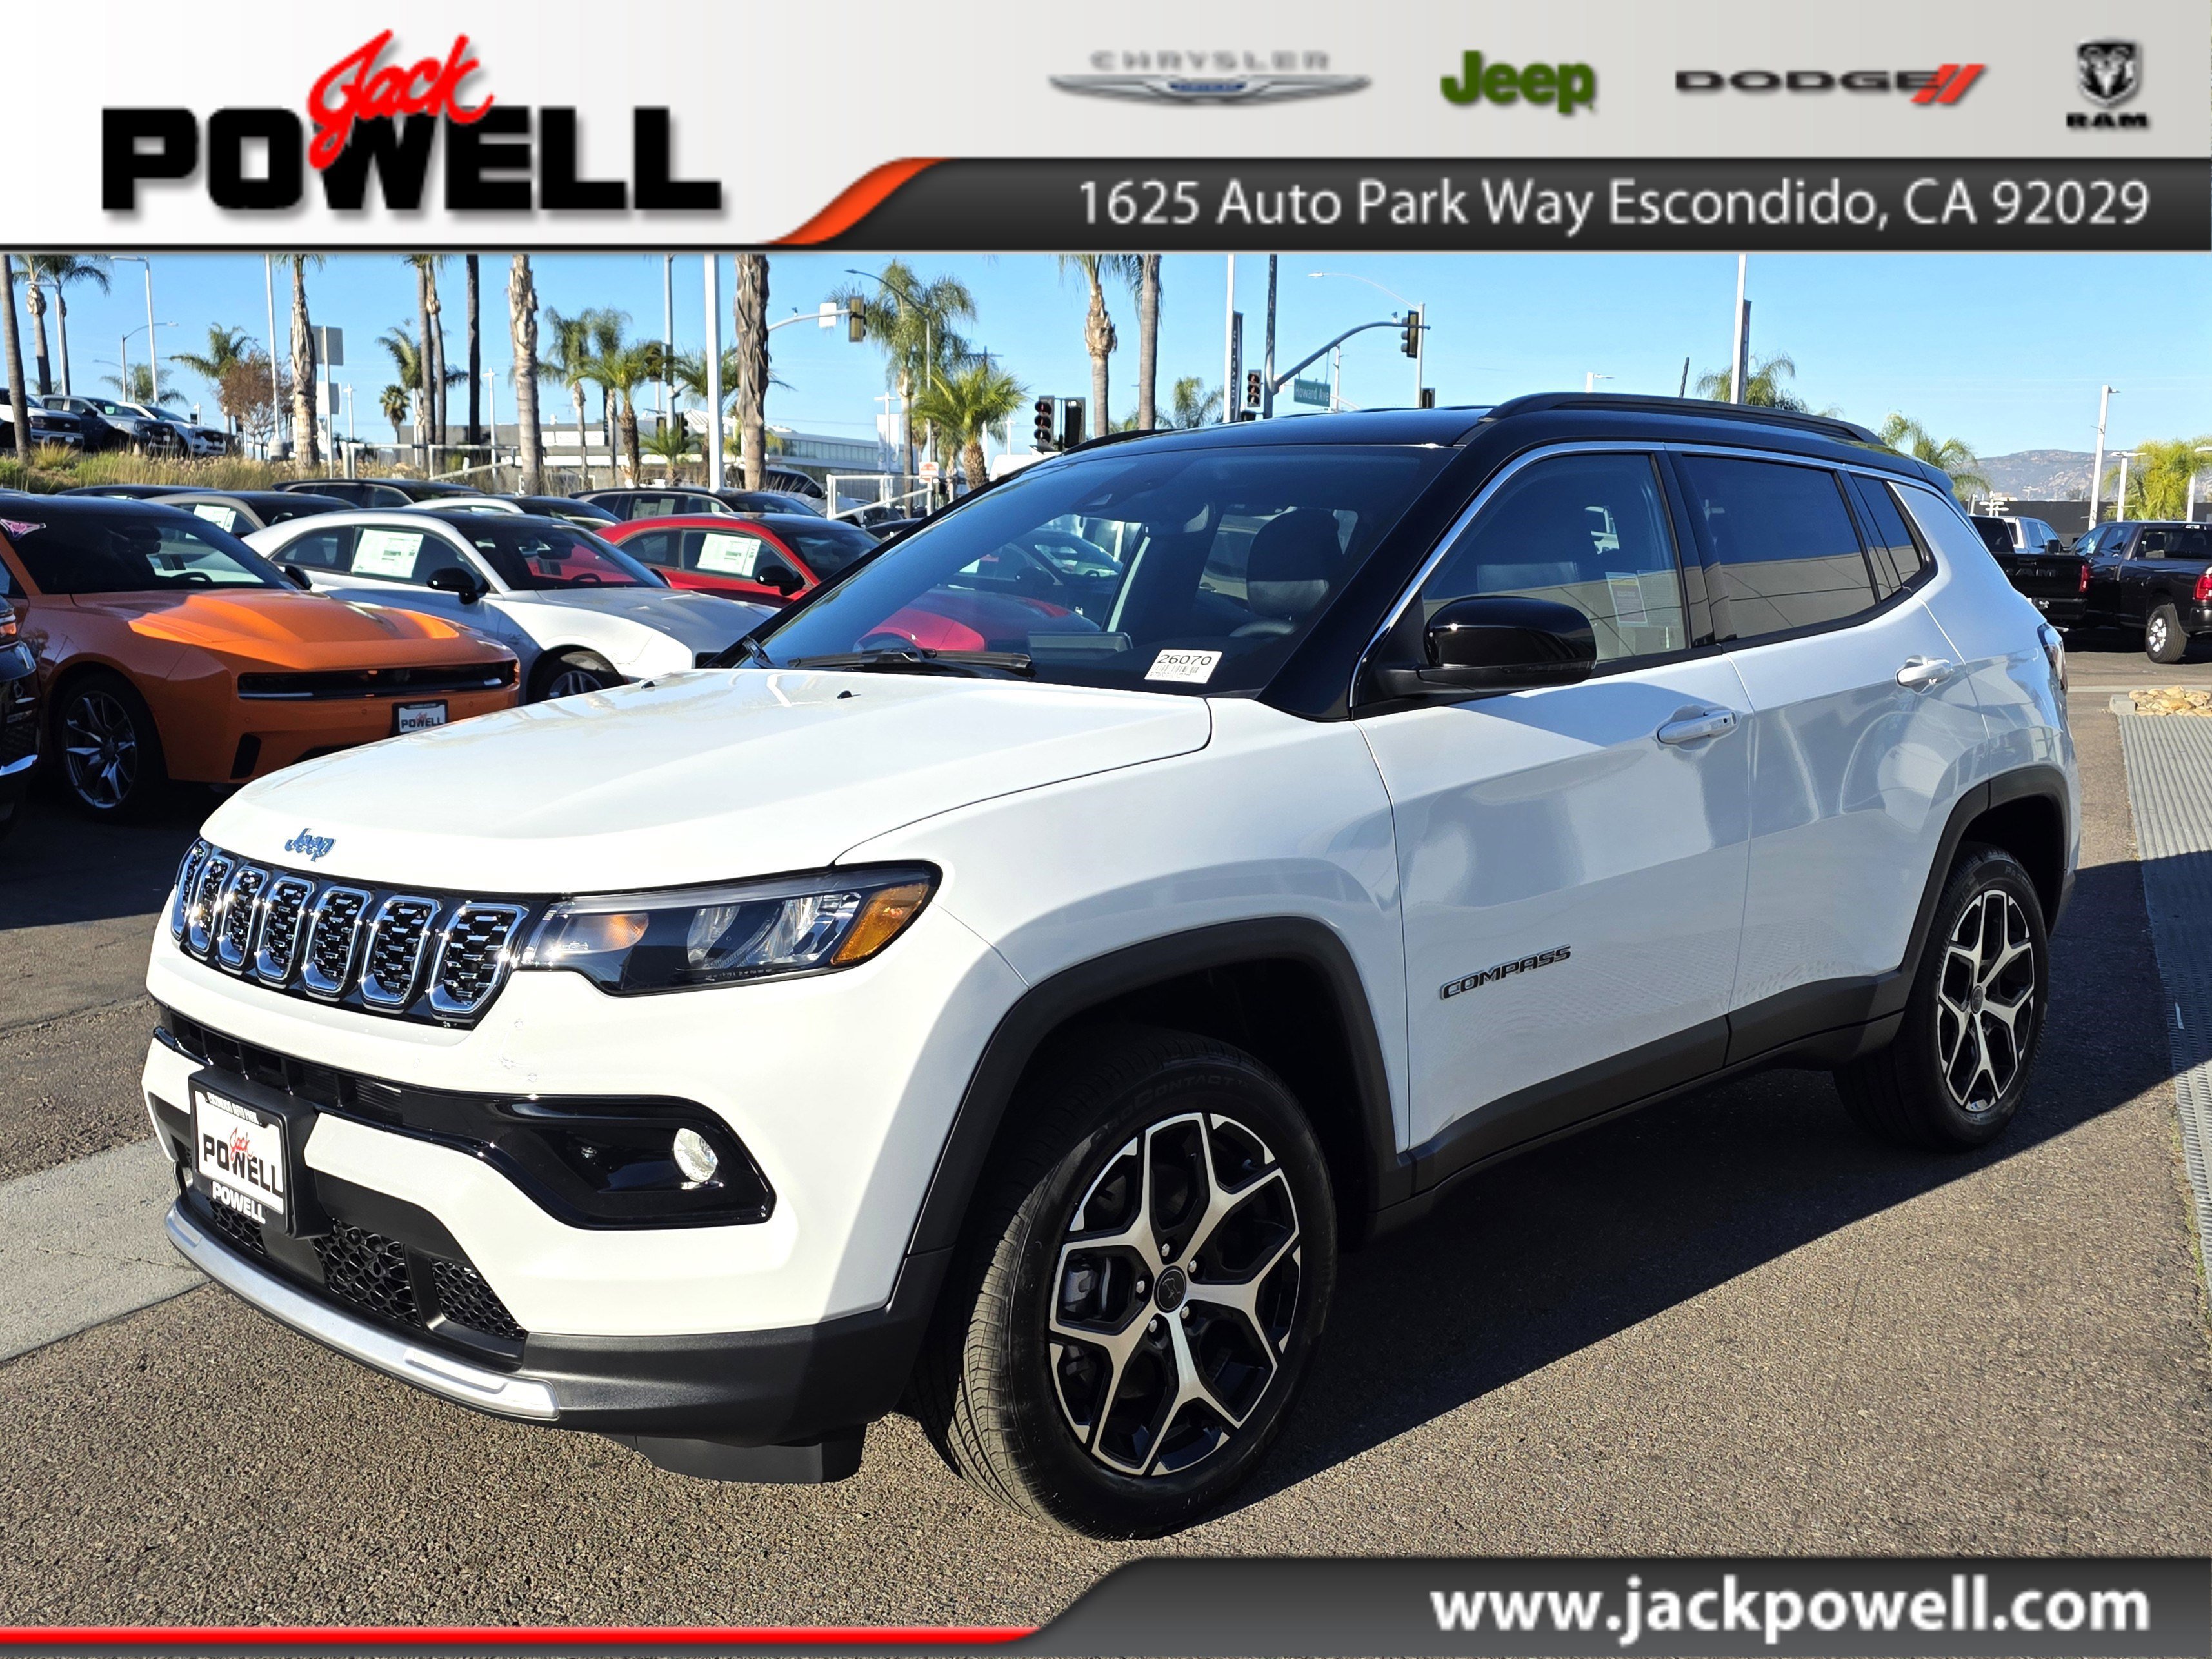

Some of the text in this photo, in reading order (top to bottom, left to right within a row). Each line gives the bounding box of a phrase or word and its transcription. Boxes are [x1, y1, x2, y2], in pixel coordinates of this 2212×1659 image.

[1295, 384, 1317, 400] Howard
[1157, 654, 1212, 665] 26070
[401, 716, 444, 729] POWELL
[284, 827, 336, 862] Jeep
[1440, 943, 1571, 1000] COMPASS
[230, 1126, 254, 1161] Jack
[203, 1132, 283, 1197] POWELL
[212, 1181, 266, 1224] POWELL
